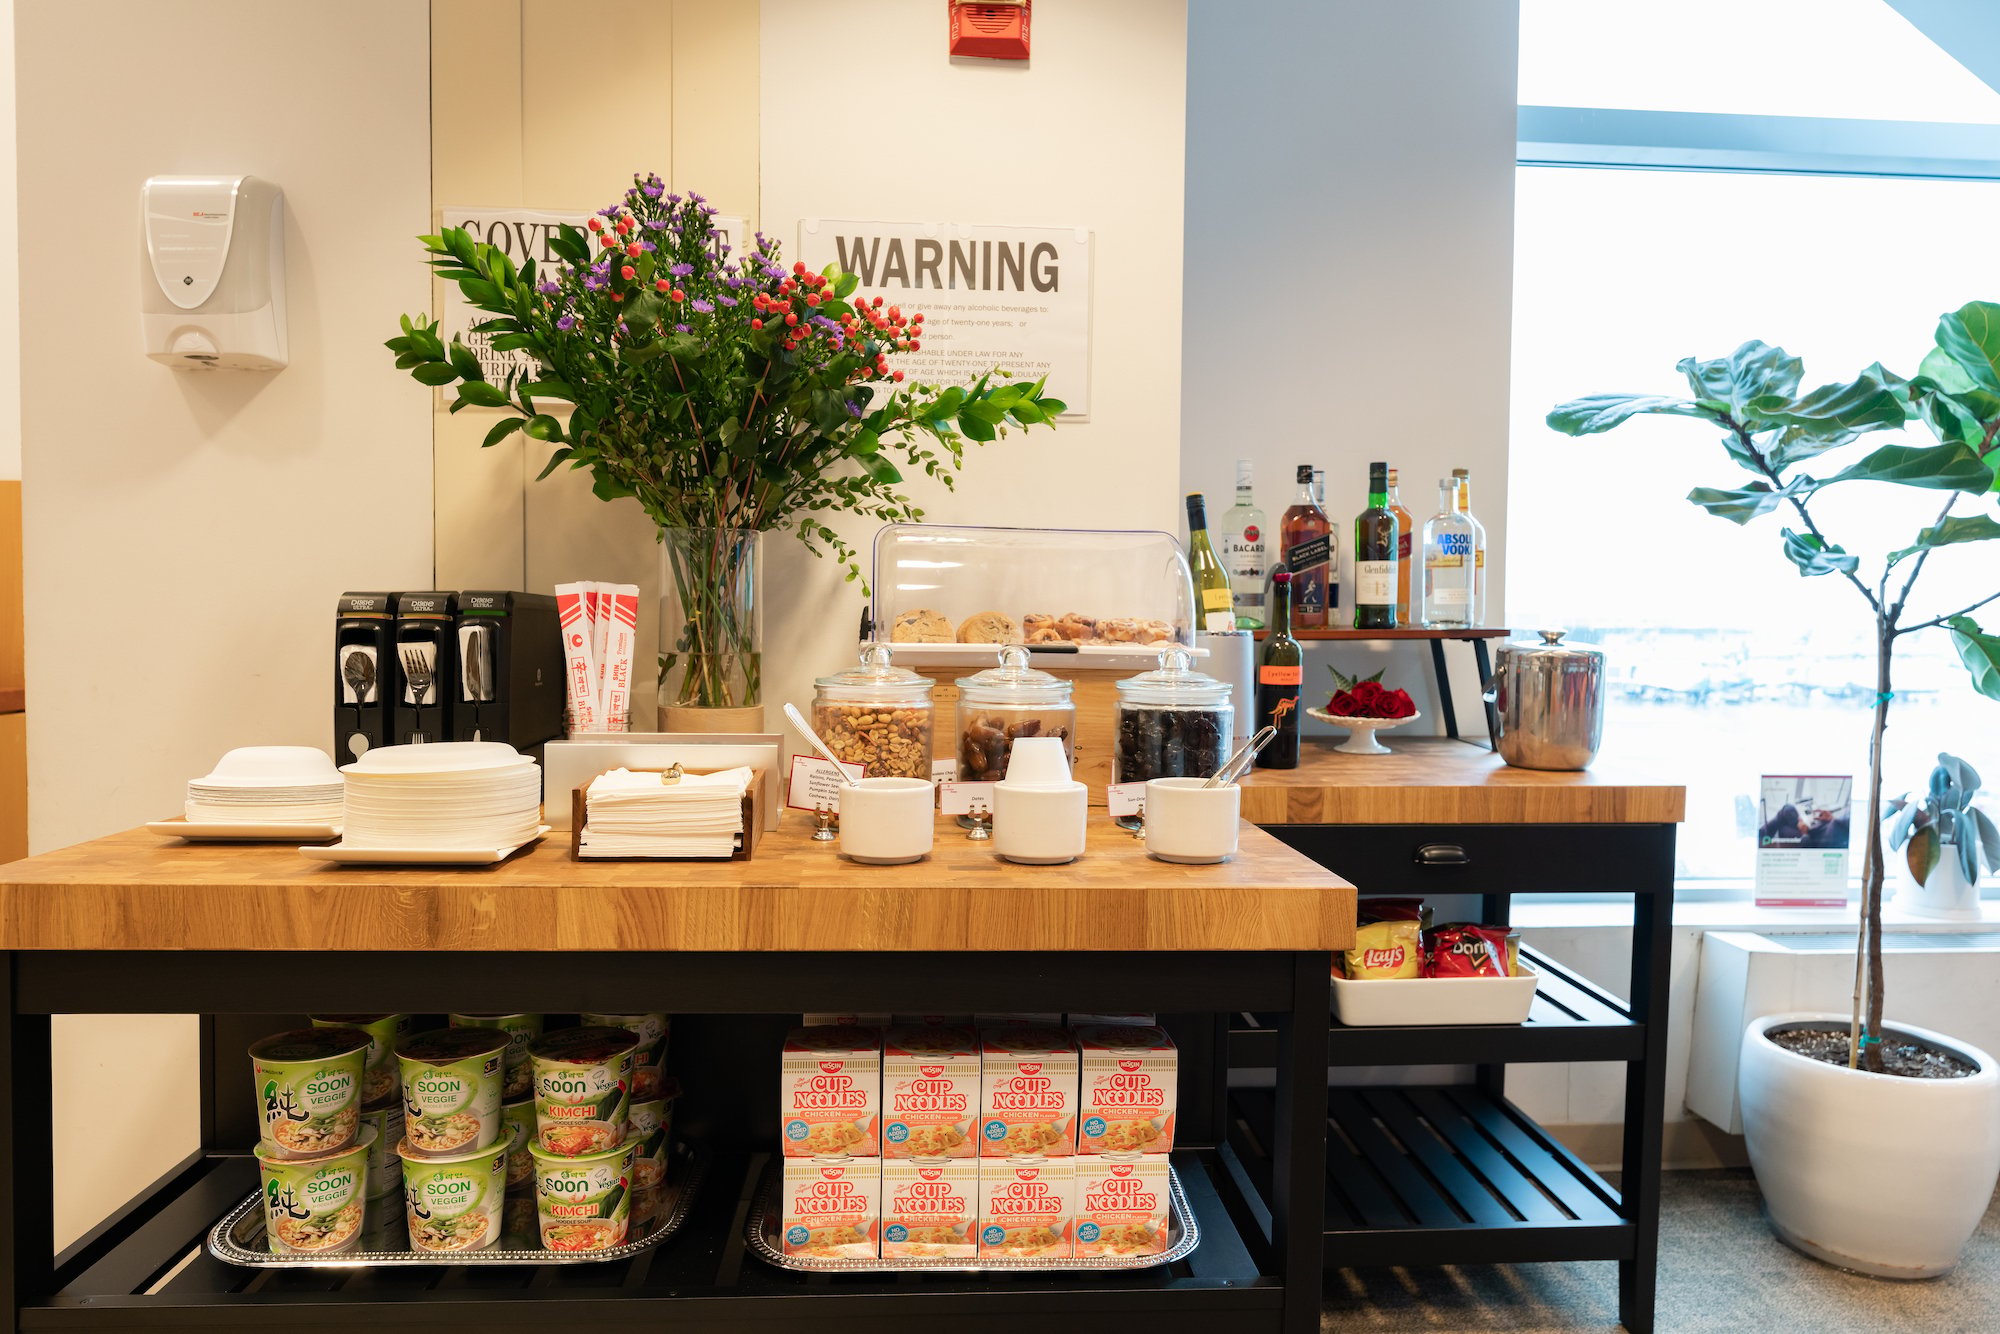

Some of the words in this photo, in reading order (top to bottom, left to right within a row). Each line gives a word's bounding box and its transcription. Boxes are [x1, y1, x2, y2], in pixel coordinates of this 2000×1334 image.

[836, 236, 1059, 292] WARNING
[1001, 305, 1038, 313] beverages
[618, 659, 627, 688] BLACK
[307, 1076, 350, 1094] SOON
[418, 1081, 460, 1092] SOON
[594, 1080, 618, 1091] Vegan
[811, 1076, 852, 1092] CUP
[912, 1080, 953, 1095] CUP
[1010, 1077, 1051, 1093] CUP
[1110, 1074, 1150, 1090] CUP
[311, 1091, 346, 1104] VEGGIE
[422, 1095, 457, 1103] VEGGIE
[794, 1091, 866, 1109] NOODLES
[894, 1094, 966, 1111] NOODLES
[993, 1092, 1064, 1109] NOODLES
[1092, 1088, 1164, 1106] NOODLES
[549, 1105, 596, 1117] KIMCHI
[493, 1160, 499, 1169] 3
[307, 1174, 351, 1193] SOON
[427, 1180, 471, 1194] SOON
[596, 1177, 620, 1189] Vegan
[812, 1182, 853, 1197] CUP
[911, 1182, 951, 1198] CUP
[1008, 1183, 1048, 1198] CUP
[1102, 1179, 1142, 1195] CUP
[312, 1188, 348, 1203] VEGGIE
[431, 1195, 468, 1205] VEGGIE
[1086, 1193, 1156, 1211] NOODLES
[552, 1205, 598, 1216] KIMCHI
[795, 1196, 867, 1214] NOODLES
[893, 1197, 965, 1214] NOODLES
[991, 1197, 1061, 1214] NOODLES
